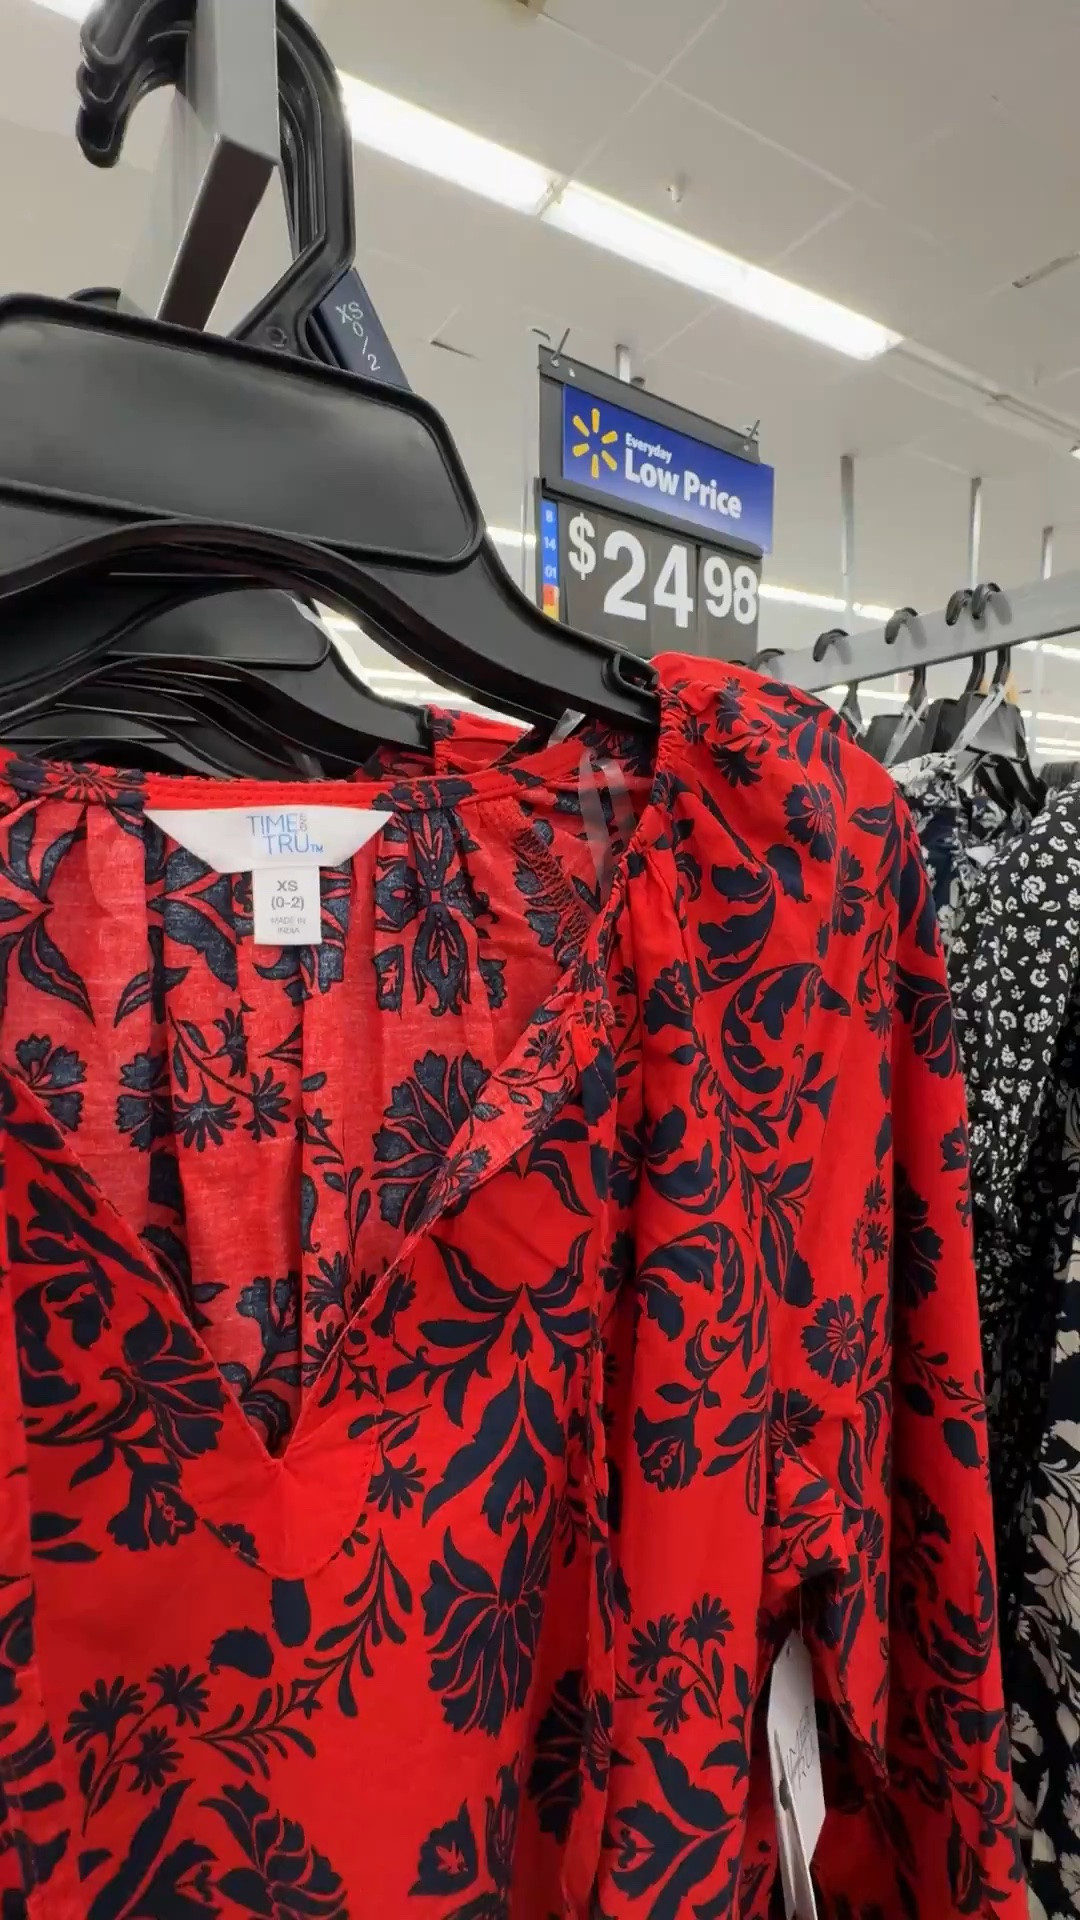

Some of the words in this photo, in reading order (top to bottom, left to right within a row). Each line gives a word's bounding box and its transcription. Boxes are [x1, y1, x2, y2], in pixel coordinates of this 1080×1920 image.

[335, 302, 364, 324] XS
[625, 432, 672, 464] Everyday
[625, 448, 680, 495] Low
[684, 470, 742, 519] Price
[247, 812, 298, 836] TIME
[276, 880, 298, 892] XS
[271, 895, 305, 911] (0-2)
[270, 915, 294, 926] MADE
